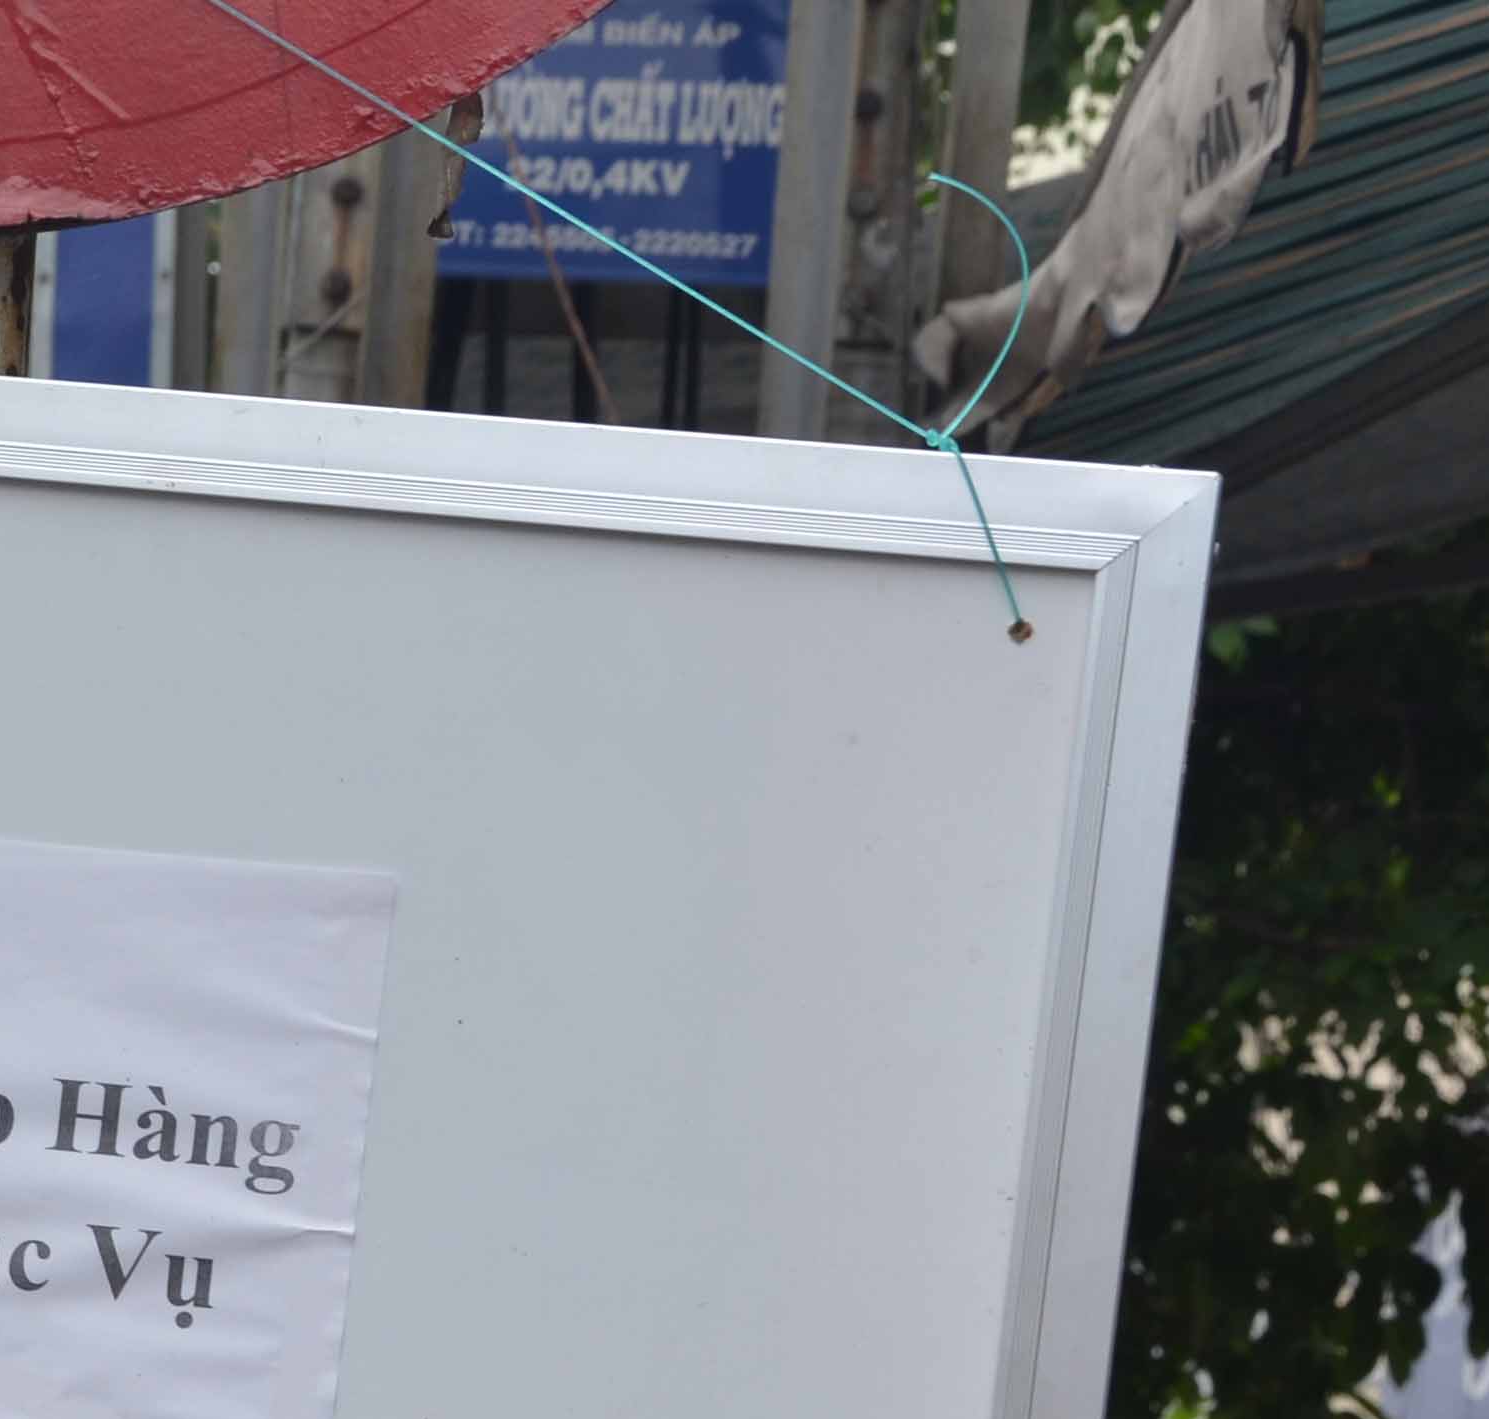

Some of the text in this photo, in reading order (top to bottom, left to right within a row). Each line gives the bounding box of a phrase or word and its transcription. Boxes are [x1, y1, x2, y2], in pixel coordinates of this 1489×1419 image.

[692, 18, 741, 46] ÁP
[589, 58, 677, 144] CHẤT
[677, 76, 785, 160] LƯỢNG
[48, 1079, 299, 1194] Hàng
[87, 1224, 213, 1328] Vụ
